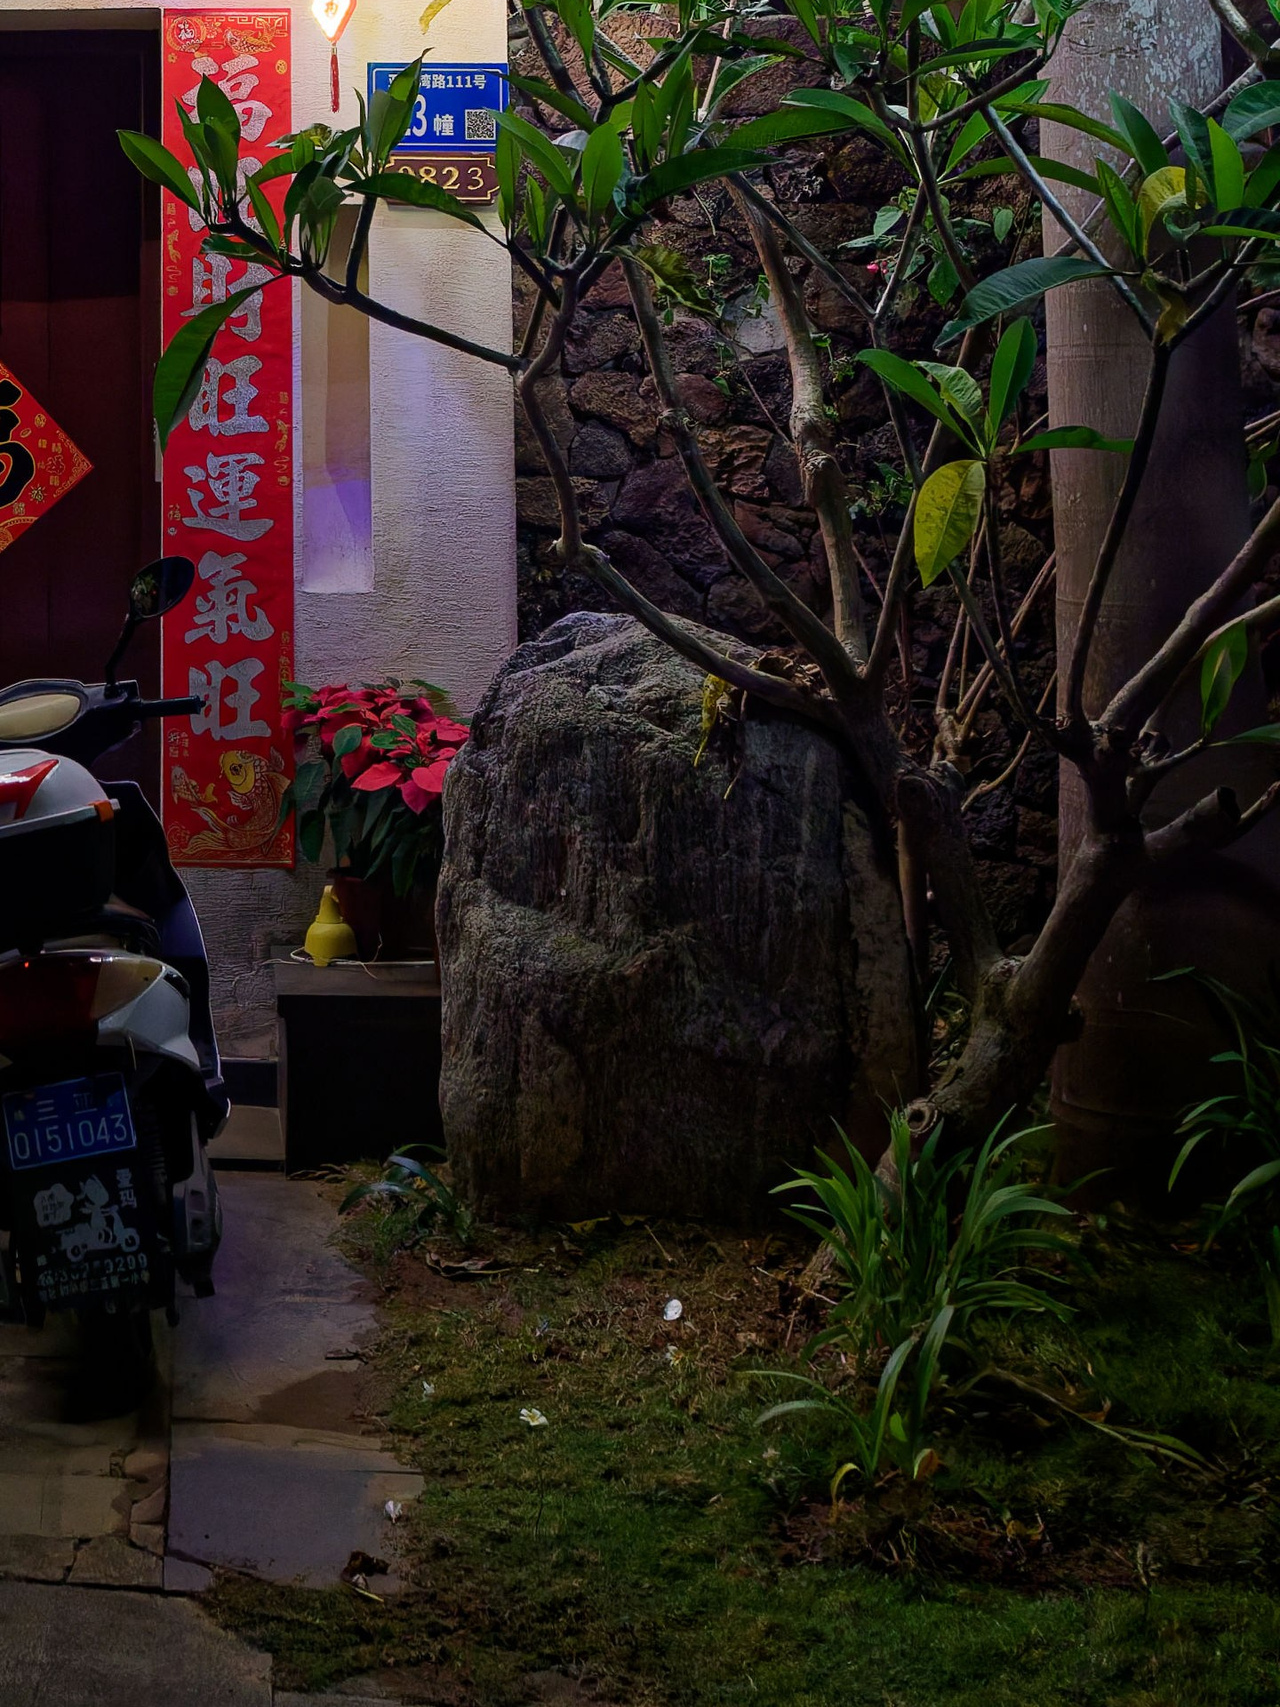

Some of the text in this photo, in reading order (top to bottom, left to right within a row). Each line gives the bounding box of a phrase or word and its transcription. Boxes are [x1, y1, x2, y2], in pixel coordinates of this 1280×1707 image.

[388, 74, 487, 90] 湾路111号
[13, 1113, 128, 1160] 0151043
